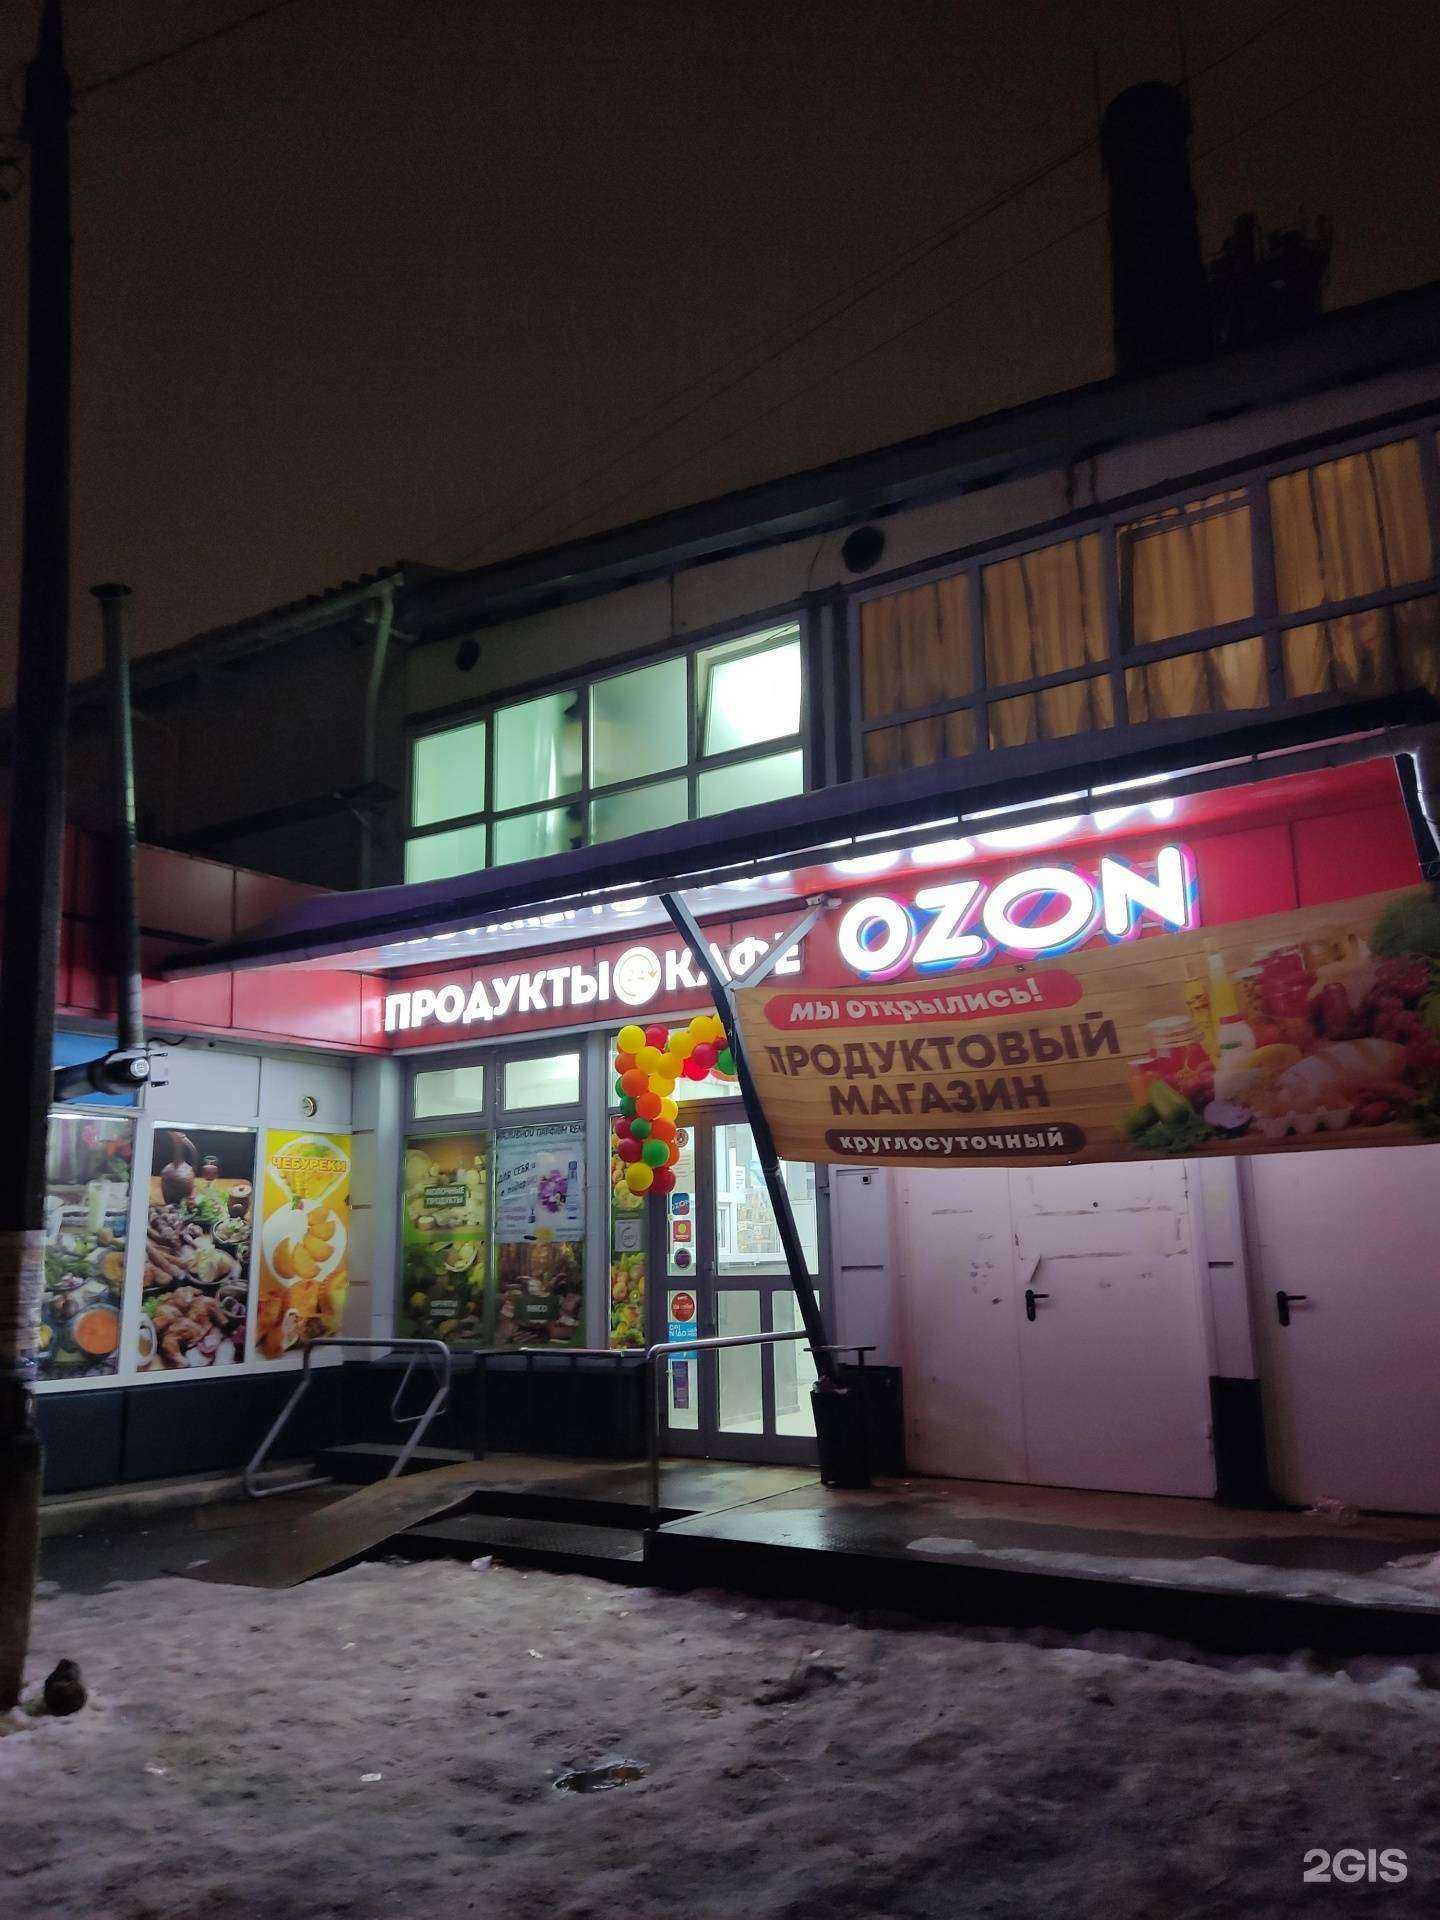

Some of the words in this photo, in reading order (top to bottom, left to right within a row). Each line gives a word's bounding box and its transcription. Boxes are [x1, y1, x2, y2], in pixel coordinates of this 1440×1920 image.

[838, 844, 1197, 977] OZON
[384, 960, 609, 1032] ПРОДУКТЫ
[765, 1011, 1121, 1080] ПРОДУКТОВЫЙ
[828, 1074, 1051, 1116] МАГАЗИН
